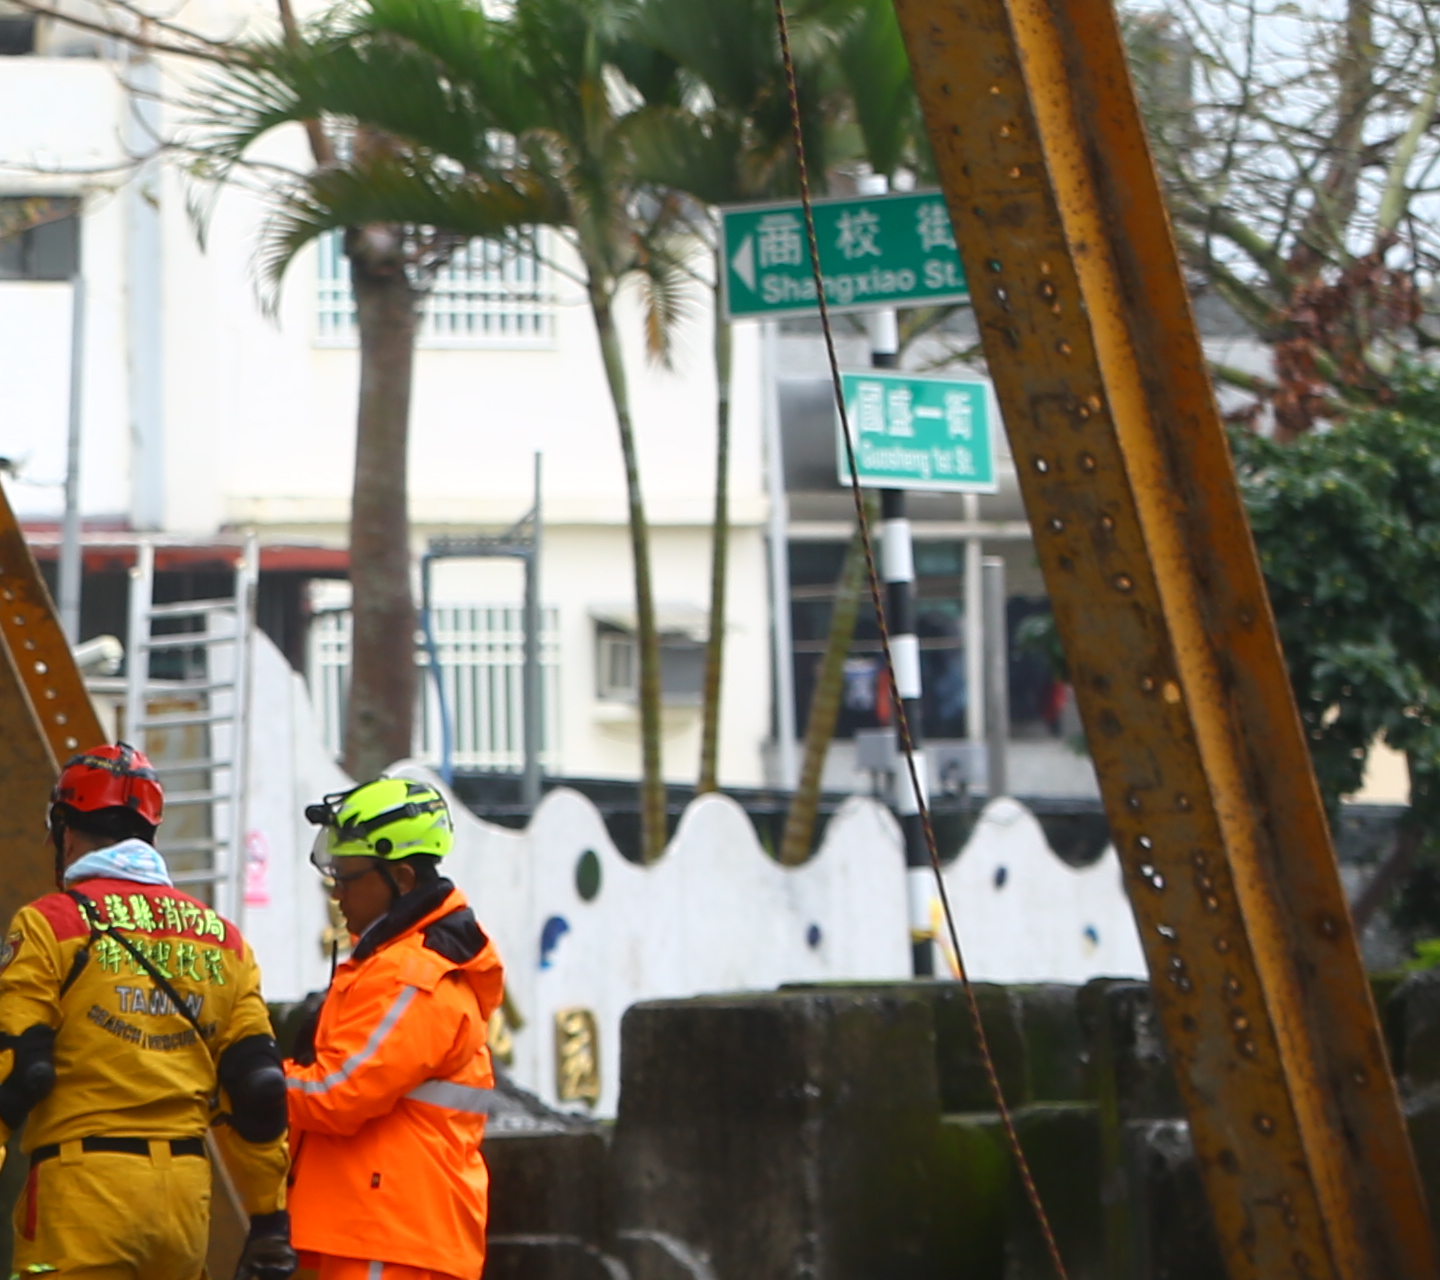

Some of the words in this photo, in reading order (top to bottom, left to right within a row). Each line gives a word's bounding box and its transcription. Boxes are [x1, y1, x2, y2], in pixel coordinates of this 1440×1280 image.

[756, 202, 958, 268] 商校街
[760, 266, 916, 304] Shangxiao
[923, 259, 964, 290] St.
